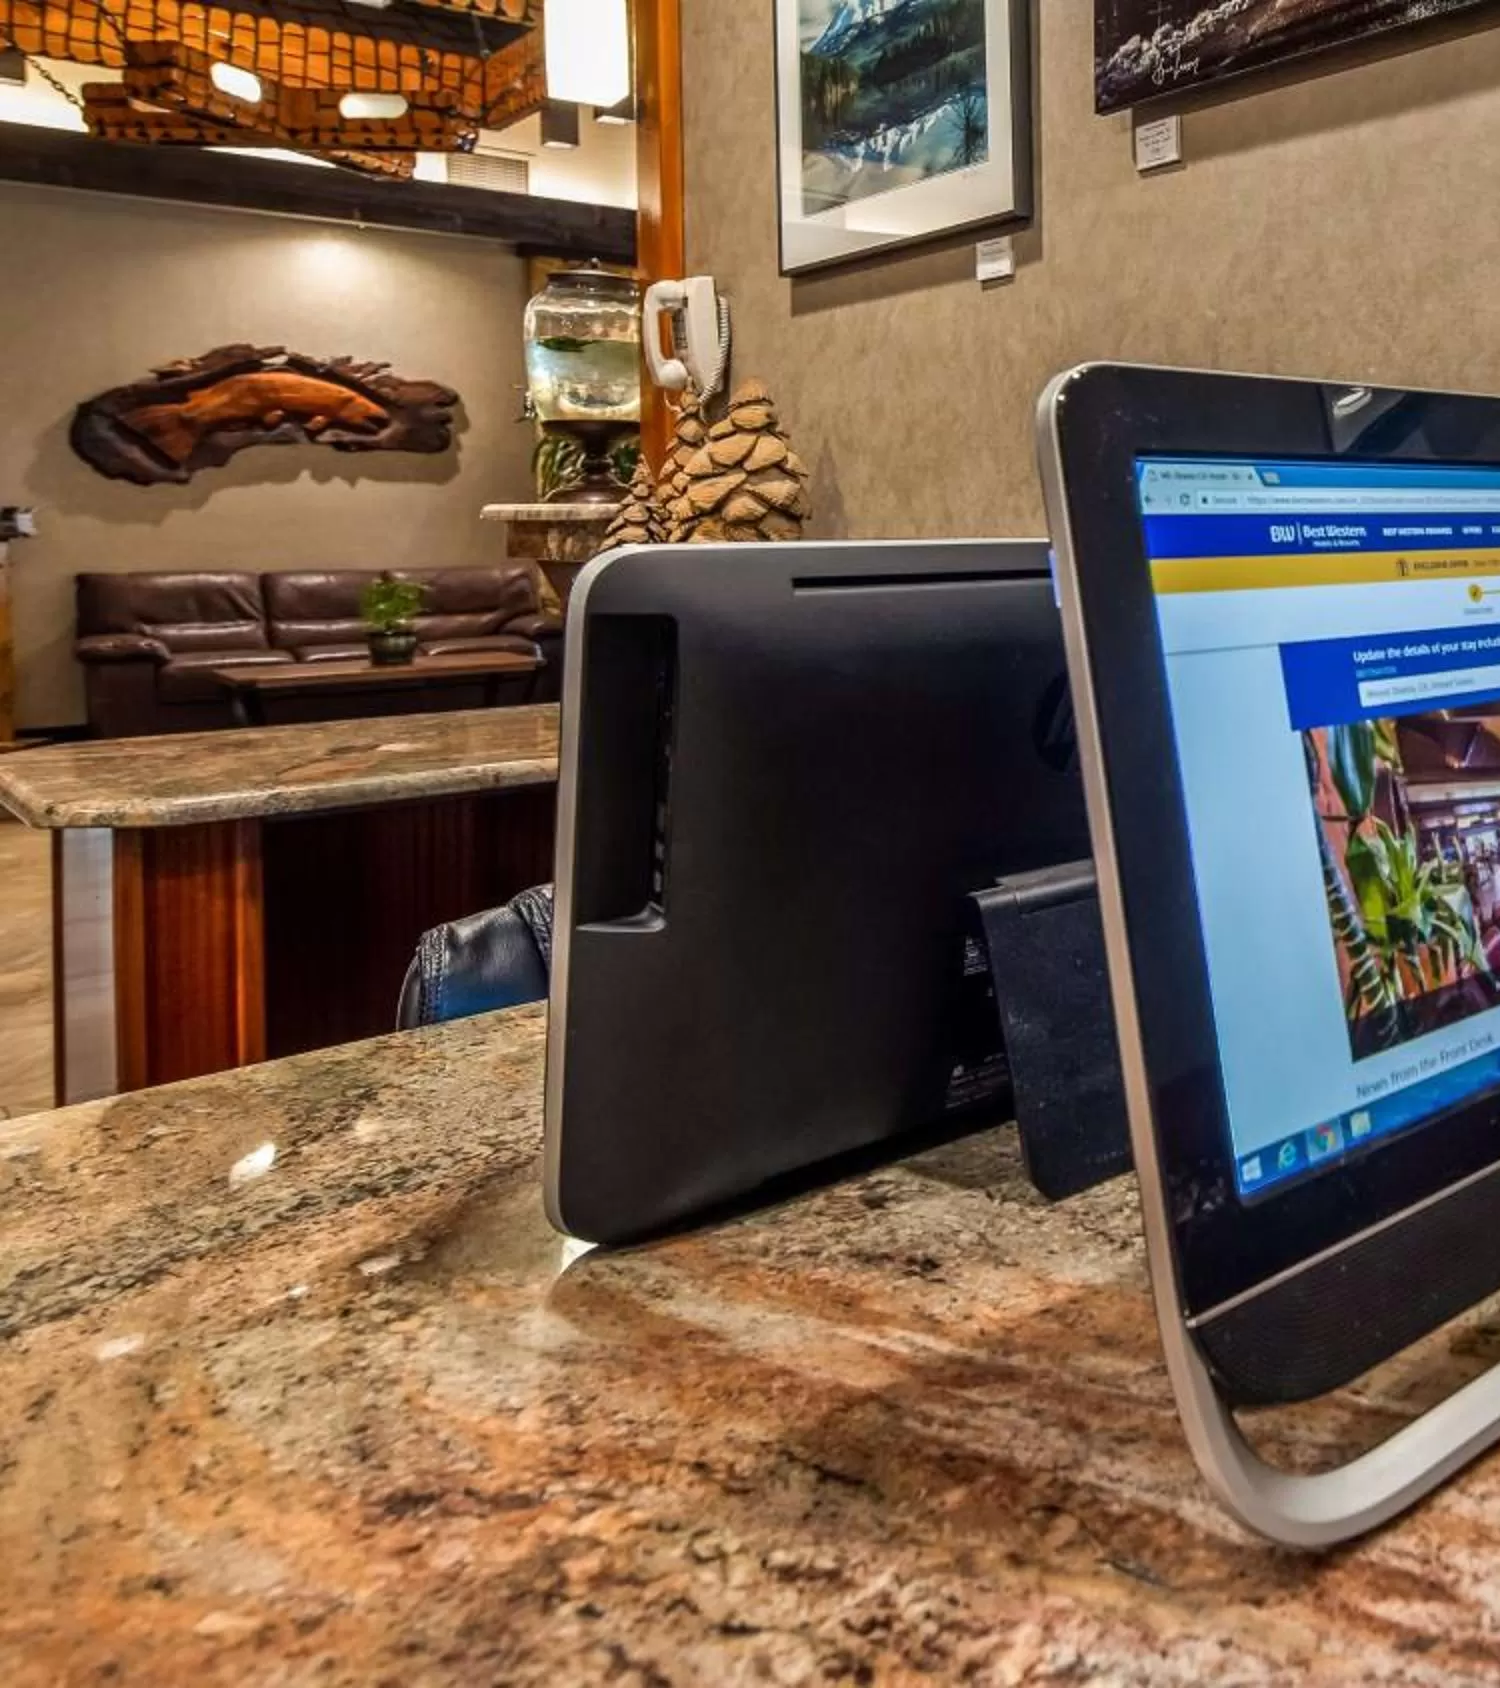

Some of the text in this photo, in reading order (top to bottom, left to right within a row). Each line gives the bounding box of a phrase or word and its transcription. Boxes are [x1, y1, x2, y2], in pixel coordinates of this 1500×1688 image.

[1325, 524, 1367, 537] Western
[1353, 649, 1385, 664] Update
[1387, 648, 1402, 659] the
[1403, 644, 1430, 657] details
[1441, 643, 1459, 655] your
[1461, 639, 1476, 652] stay
[1390, 1064, 1418, 1083] from
